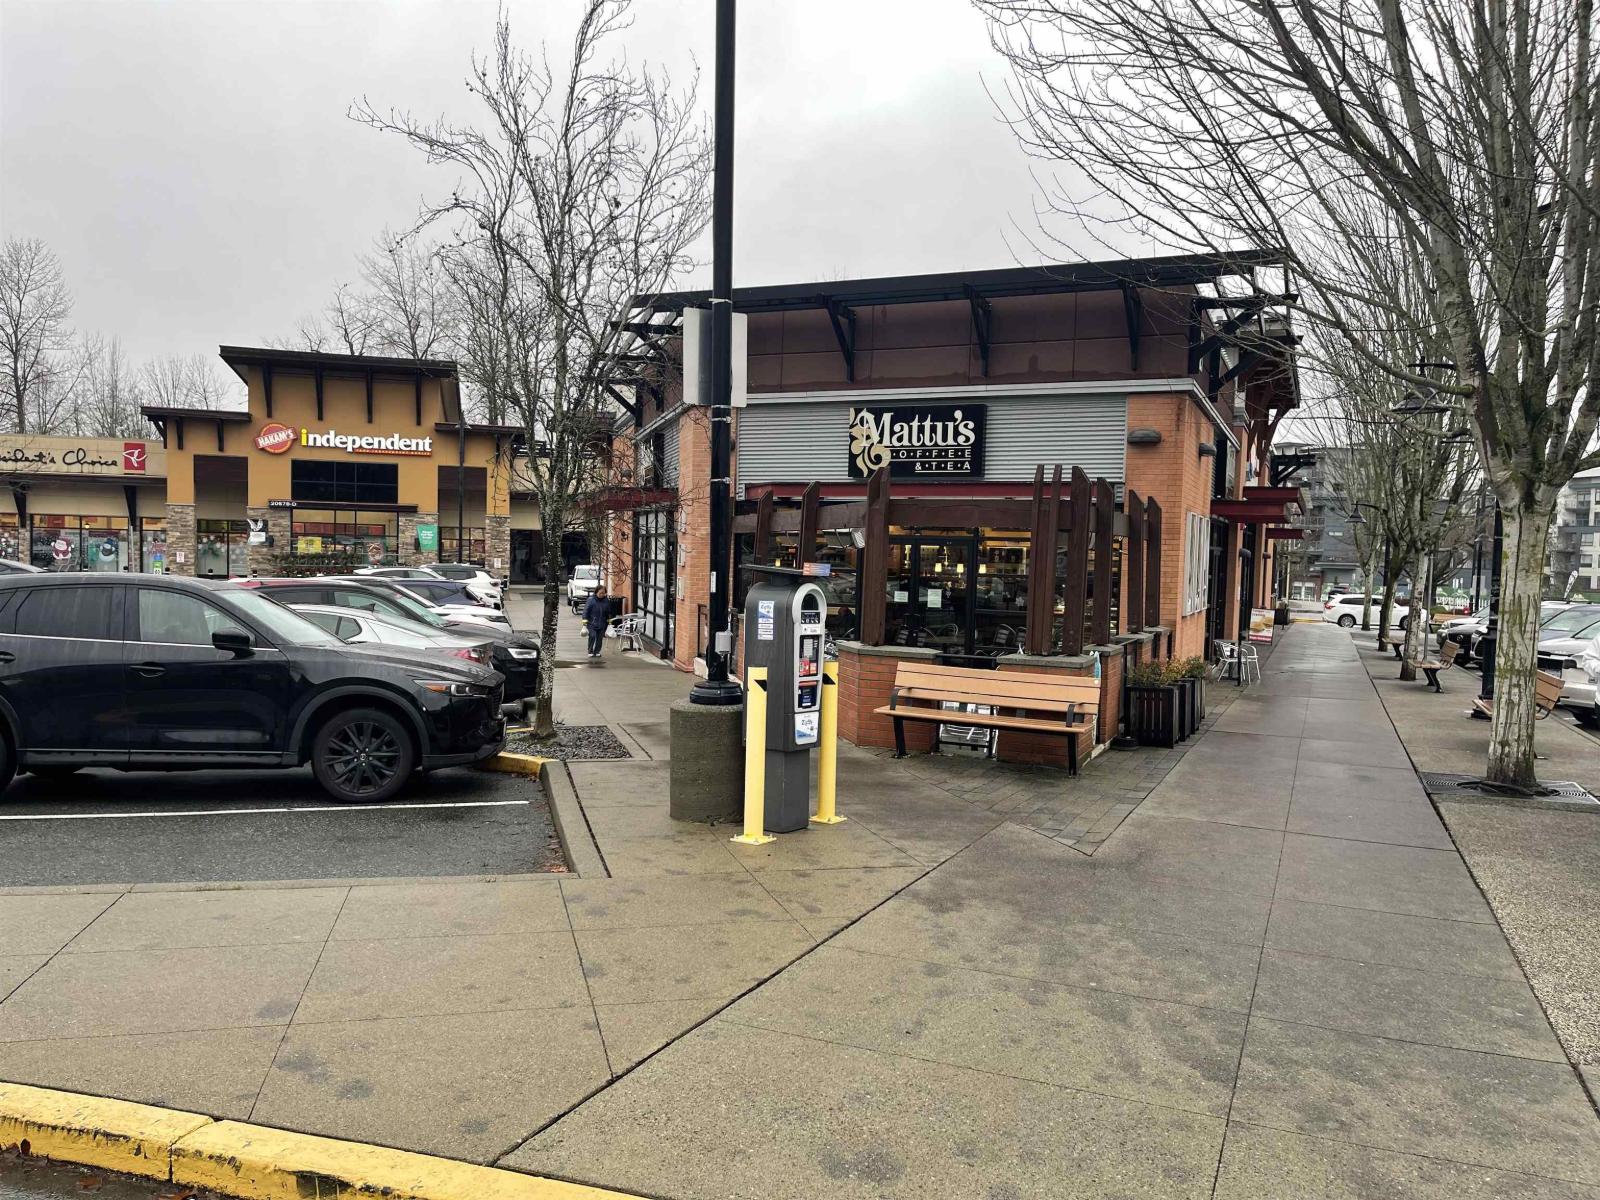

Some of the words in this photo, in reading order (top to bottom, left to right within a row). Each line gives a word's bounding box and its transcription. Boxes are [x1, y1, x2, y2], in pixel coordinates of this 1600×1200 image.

[257, 428, 296, 448] HAKAM'S
[854, 408, 976, 447] Mattu's
[301, 428, 433, 452] independent
[0, 448, 57, 465] sident's
[62, 447, 119, 466] Choice
